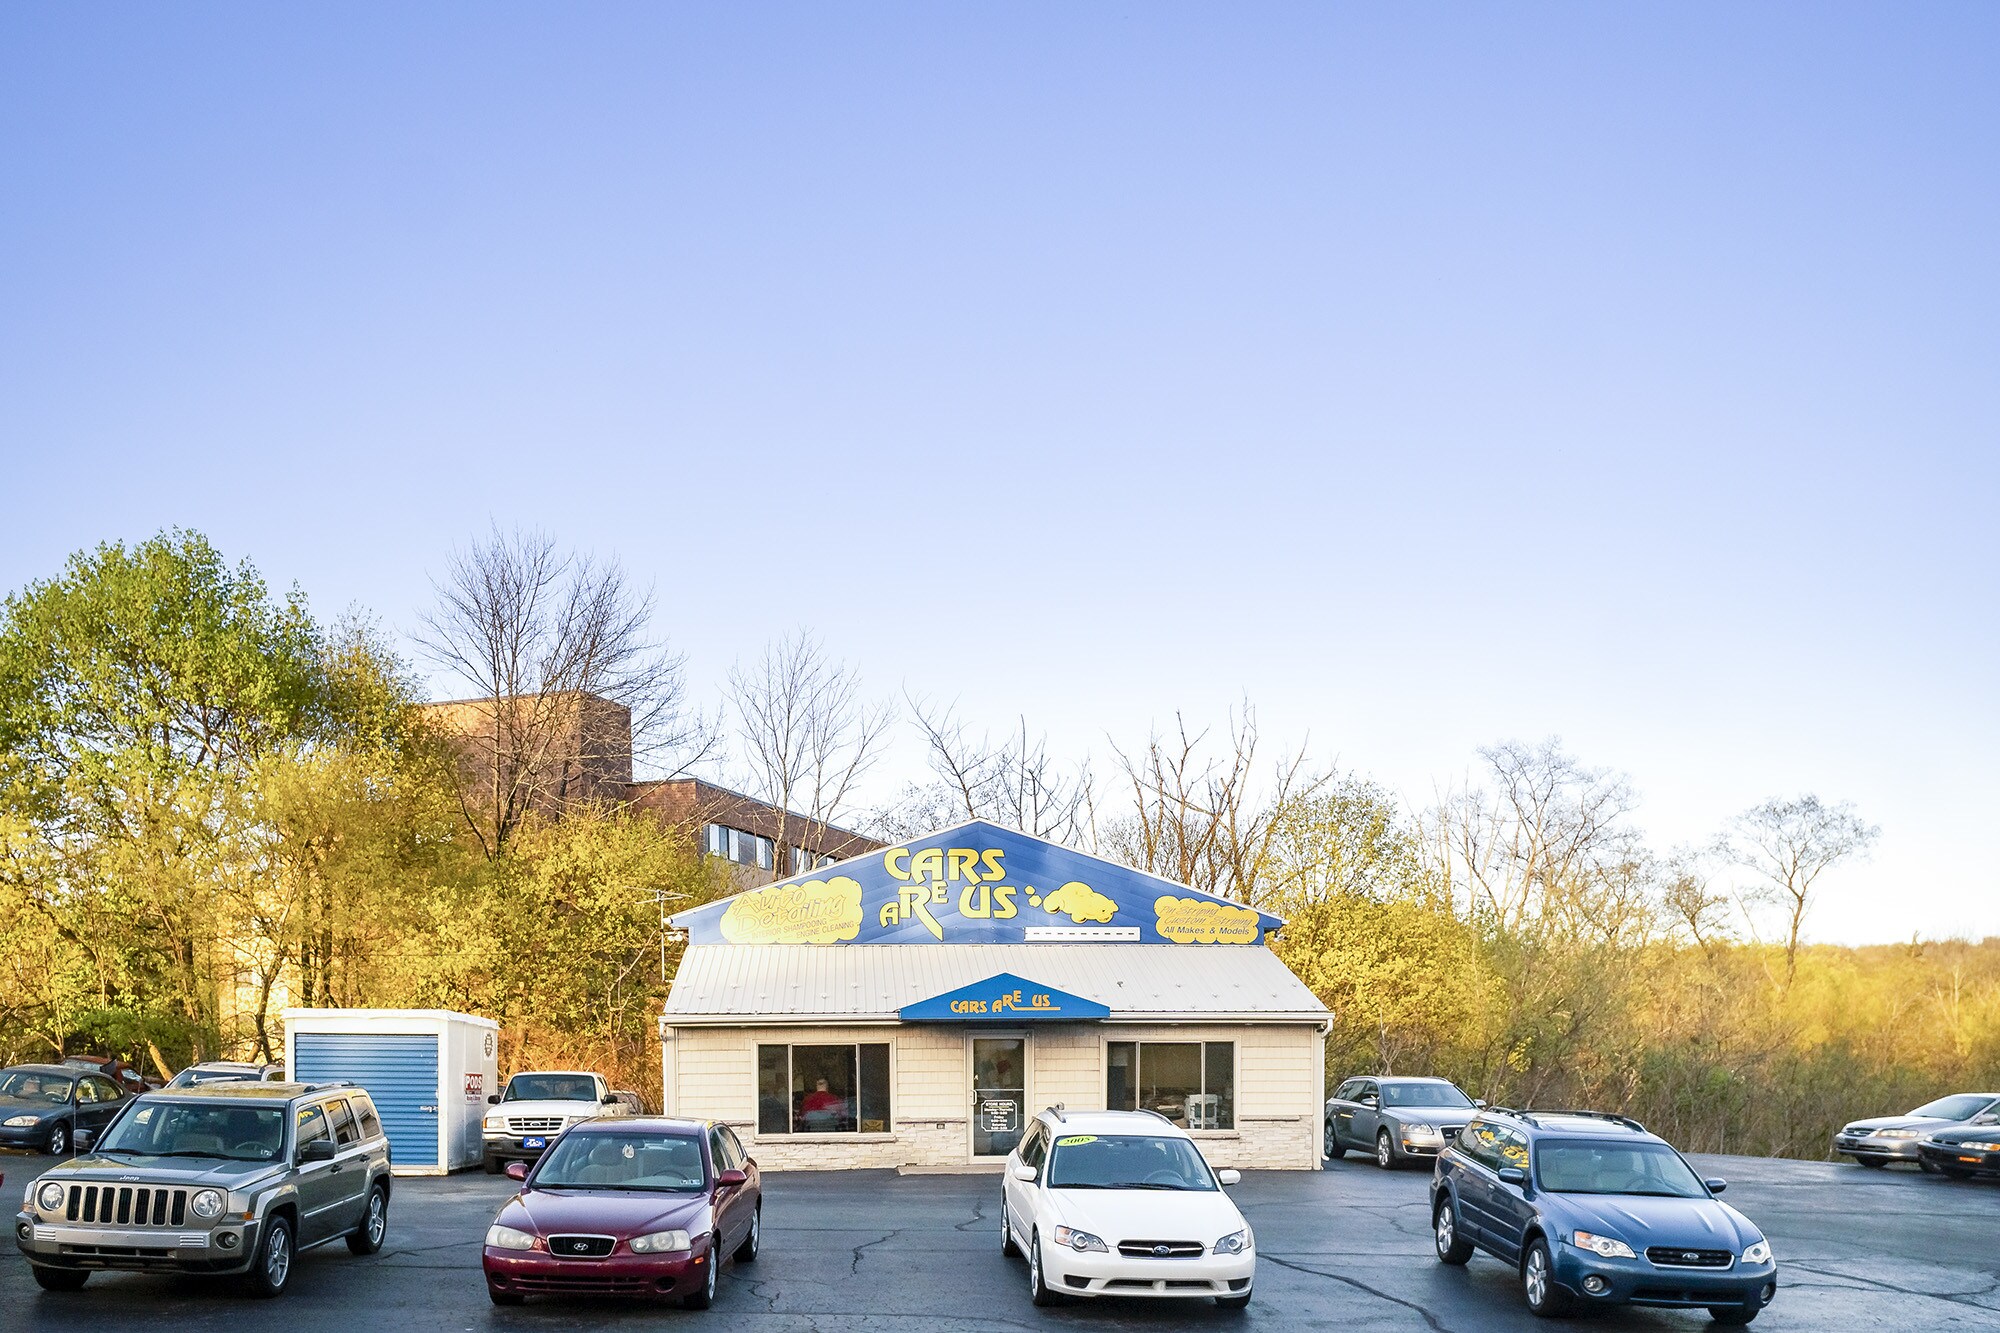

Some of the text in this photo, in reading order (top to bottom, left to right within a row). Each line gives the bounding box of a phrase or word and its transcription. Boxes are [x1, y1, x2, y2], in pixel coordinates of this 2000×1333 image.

[883, 848, 1007, 885] CARS
[733, 888, 807, 915] Auto
[958, 885, 1018, 919] US
[735, 895, 847, 935] Detailing
[751, 918, 827, 939] INTERIOR SHAMPOOING
[796, 921, 855, 938] ENGINE CLEANING
[1163, 926, 1250, 935] All Makes & Models
[950, 990, 1051, 1014] CARS ARE US
[464, 1075, 482, 1089] PODS
[119, 1174, 140, 1182] Jeep
